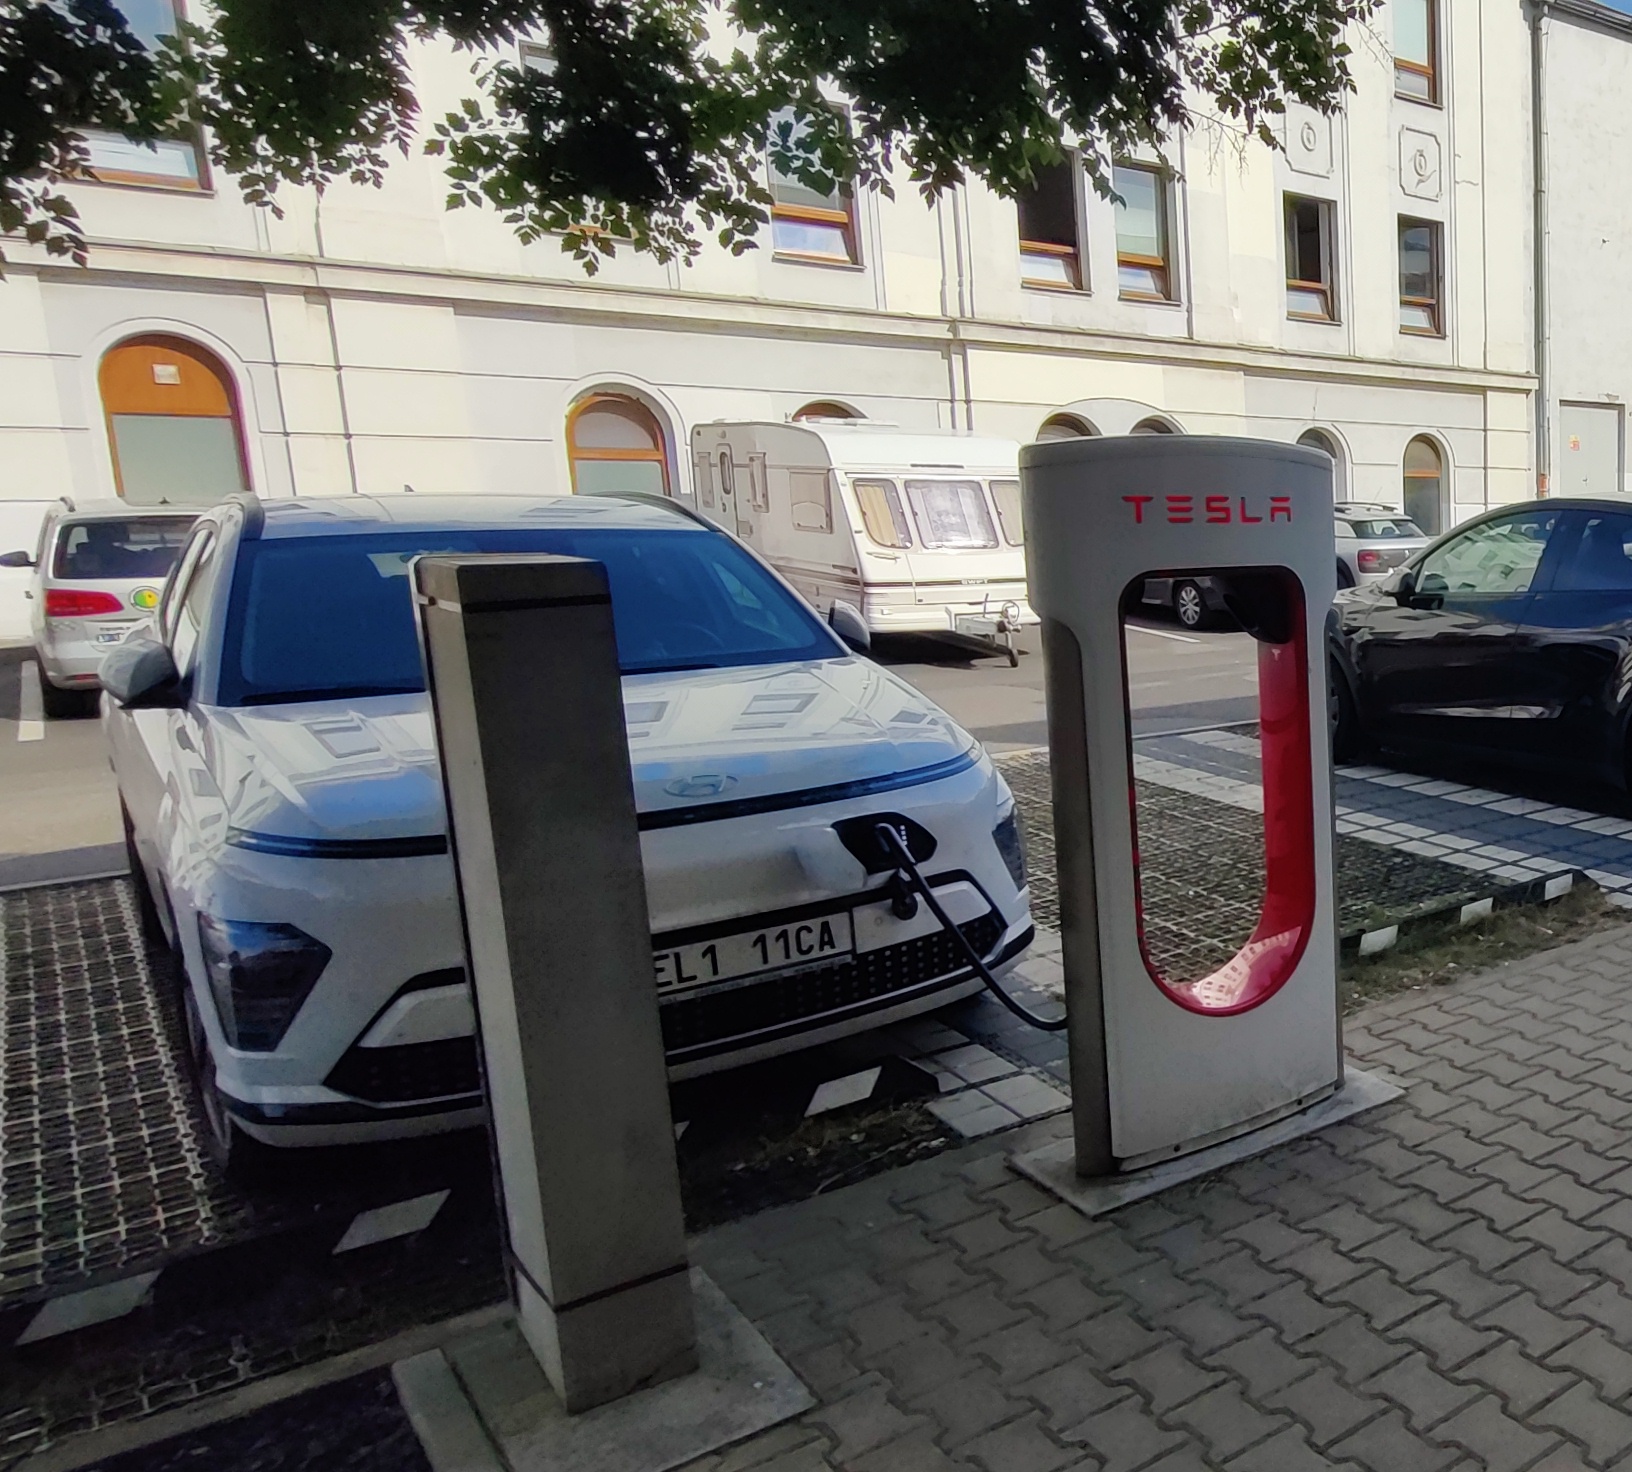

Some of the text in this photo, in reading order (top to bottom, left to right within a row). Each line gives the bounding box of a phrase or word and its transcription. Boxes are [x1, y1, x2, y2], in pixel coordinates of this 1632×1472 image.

[1121, 495, 1292, 524] TESLA
[653, 943, 719, 988] EL1
[752, 920, 836, 966] 11CA
